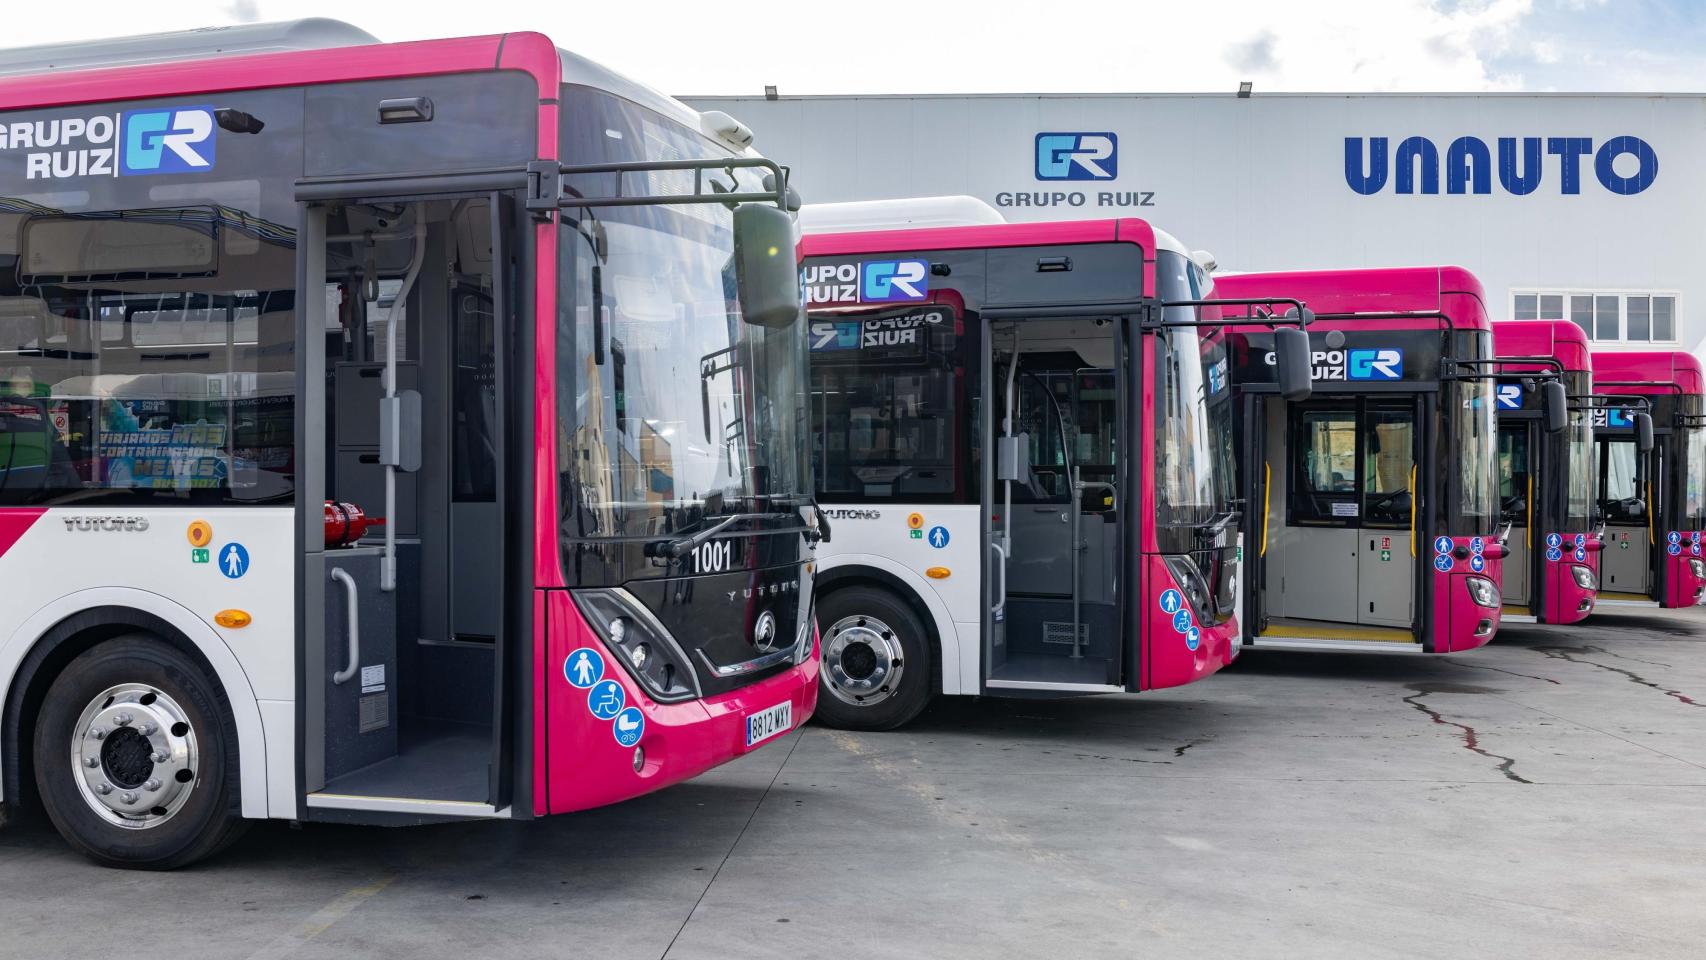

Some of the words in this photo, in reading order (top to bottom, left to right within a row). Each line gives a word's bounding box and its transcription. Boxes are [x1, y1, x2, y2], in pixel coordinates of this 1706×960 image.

[126, 109, 214, 170] GR
[26, 148, 113, 179] RUIZ
[1038, 135, 1113, 177] GR
[1344, 136, 1659, 195] UNAUTO
[995, 192, 1086, 207] GRUPO
[1098, 192, 1155, 207] RUIZ
[865, 262, 925, 298] GR
[1264, 351, 1343, 365] GPO
[1350, 350, 1401, 377] GR
[1310, 366, 1344, 380] UIZ
[62, 515, 149, 532] YUTONG
[820, 509, 881, 520] YUTONG
[691, 540, 731, 573] 1001
[752, 711, 773, 740] 8812
